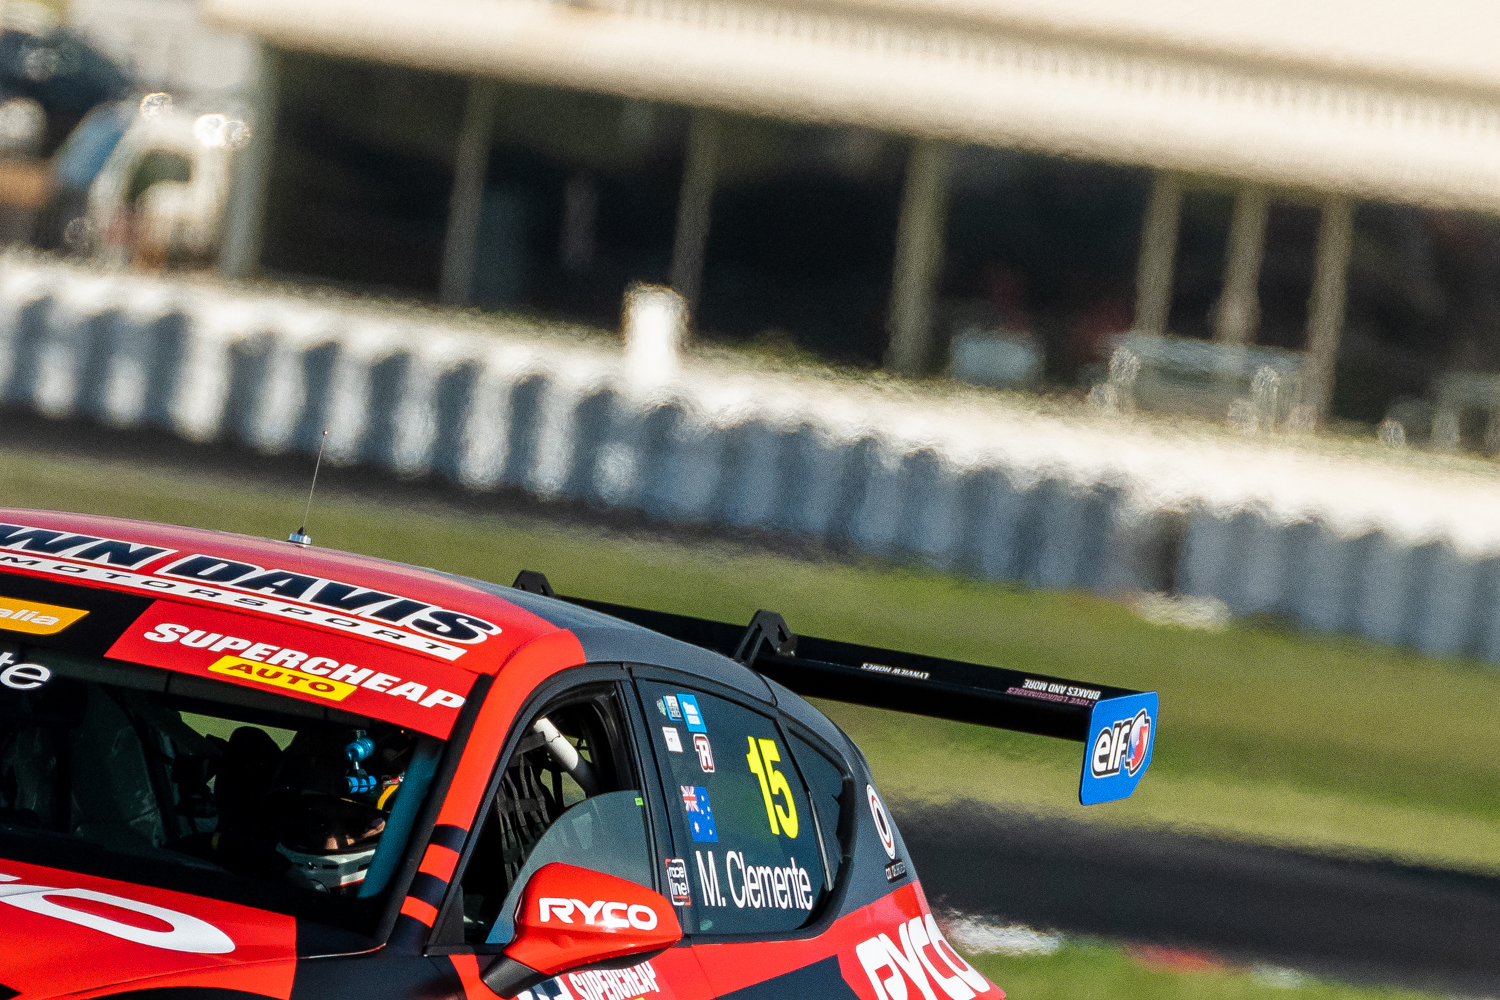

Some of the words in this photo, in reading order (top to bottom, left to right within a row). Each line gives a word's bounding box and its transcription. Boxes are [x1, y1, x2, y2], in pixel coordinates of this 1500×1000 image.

[154, 553, 503, 645] DAVIS
[143, 622, 467, 708] SUPERCHEAP
[228, 661, 337, 693] AUTO
[1022, 679, 1048, 692] MORE
[1048, 683, 1067, 694] AND
[1067, 687, 1101, 701] BRAKES
[1093, 719, 1132, 774] elf
[746, 736, 798, 839] 15
[695, 850, 726, 907] M.
[726, 850, 813, 911] Clemente
[539, 897, 658, 931] RYCO
